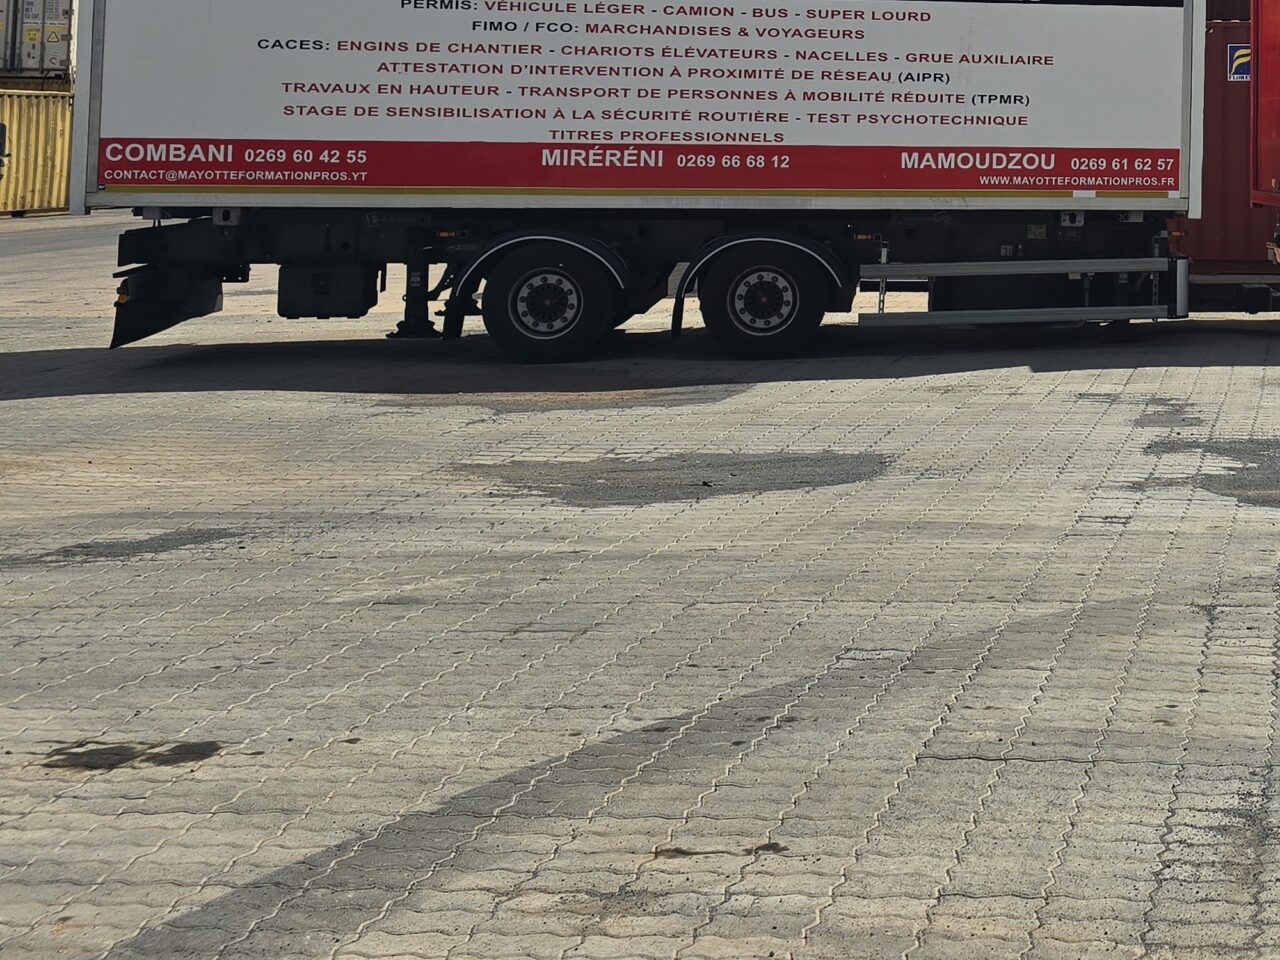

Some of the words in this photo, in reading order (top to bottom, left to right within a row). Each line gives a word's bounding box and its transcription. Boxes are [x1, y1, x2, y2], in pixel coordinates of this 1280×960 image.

[401, 0, 477, 10] PERMIS:
[484, 0, 576, 12] VÉHICULE
[584, 2, 644, 14] LÉGER
[663, 5, 733, 16] CAMION
[752, 8, 787, 17] BUS
[806, 9, 864, 20] SUPER
[872, 11, 930, 21] LOURD
[472, 21, 517, 31] FIMO
[536, 22, 578, 32] FCO:
[586, 23, 731, 36] MARCHANDISES
[756, 28, 864, 39] VOYAGEURS
[257, 39, 329, 50] CACES:
[338, 40, 408, 51] ENGINS
[416, 42, 440, 52] DE
[448, 43, 542, 54] CHANTIER
[561, 45, 654, 56] CHARIOTS
[662, 45, 777, 59] ÉLÉVATEURS
[796, 50, 887, 61] NACELLES
[906, 53, 953, 63] GRUE
[958, 54, 1053, 65] AUXILIAIRE
[377, 62, 503, 73] ATTESTATION
[669, 66, 681, 77] À
[688, 68, 784, 79] PROXIMITÉ
[792, 70, 814, 79] DE
[821, 69, 891, 81] RÉSEAU
[898, 72, 950, 84] (AIPR)
[281, 82, 370, 93] TRAVAUX
[378, 84, 401, 94] EN
[410, 84, 499, 95] HAUTEUR
[518, 86, 631, 97] TRANSPORT
[637, 88, 660, 98] DE
[668, 89, 777, 100] PERSONNES
[784, 89, 796, 100] À
[803, 91, 884, 102] MOBILITÉ
[892, 91, 964, 103] RÉDUITE
[972, 94, 1029, 106] (TPMR)
[283, 105, 346, 116] STAGE
[354, 106, 378, 116] DE
[386, 107, 546, 118] SENSIBILISATION
[553, 107, 565, 119] À
[572, 110, 595, 119] LA
[601, 108, 691, 120] SÉCURITÉ
[698, 110, 788, 122] ROUTIÈRE
[806, 113, 850, 123] TEST
[857, 114, 1027, 125] PSYCHOTECHNIQUE
[549, 130, 613, 140] TITRES
[620, 131, 784, 142] PROFESSIONNELS
[106, 143, 232, 161] COMBANI
[245, 149, 286, 162] 0269
[293, 149, 312, 162] 60
[319, 150, 339, 162] 42
[346, 150, 366, 163] 55
[542, 146, 662, 166] MIRÉRÉNI
[677, 154, 715, 167] 0269
[722, 155, 740, 167] 66
[746, 155, 764, 167] 68
[772, 155, 789, 167] 12
[901, 152, 1055, 169] MAMOUDZOU
[1071, 158, 1106, 170] 0269
[1112, 158, 1127, 170] 61
[1134, 158, 1151, 170] 62
[1157, 159, 1174, 170] 57
[104, 170, 367, 181] CONTACT@MAYOTTEFORMATIONPROS.YT
[980, 176, 1175, 186] WWW.MAYOTTEFORMATIONPROS.FR
